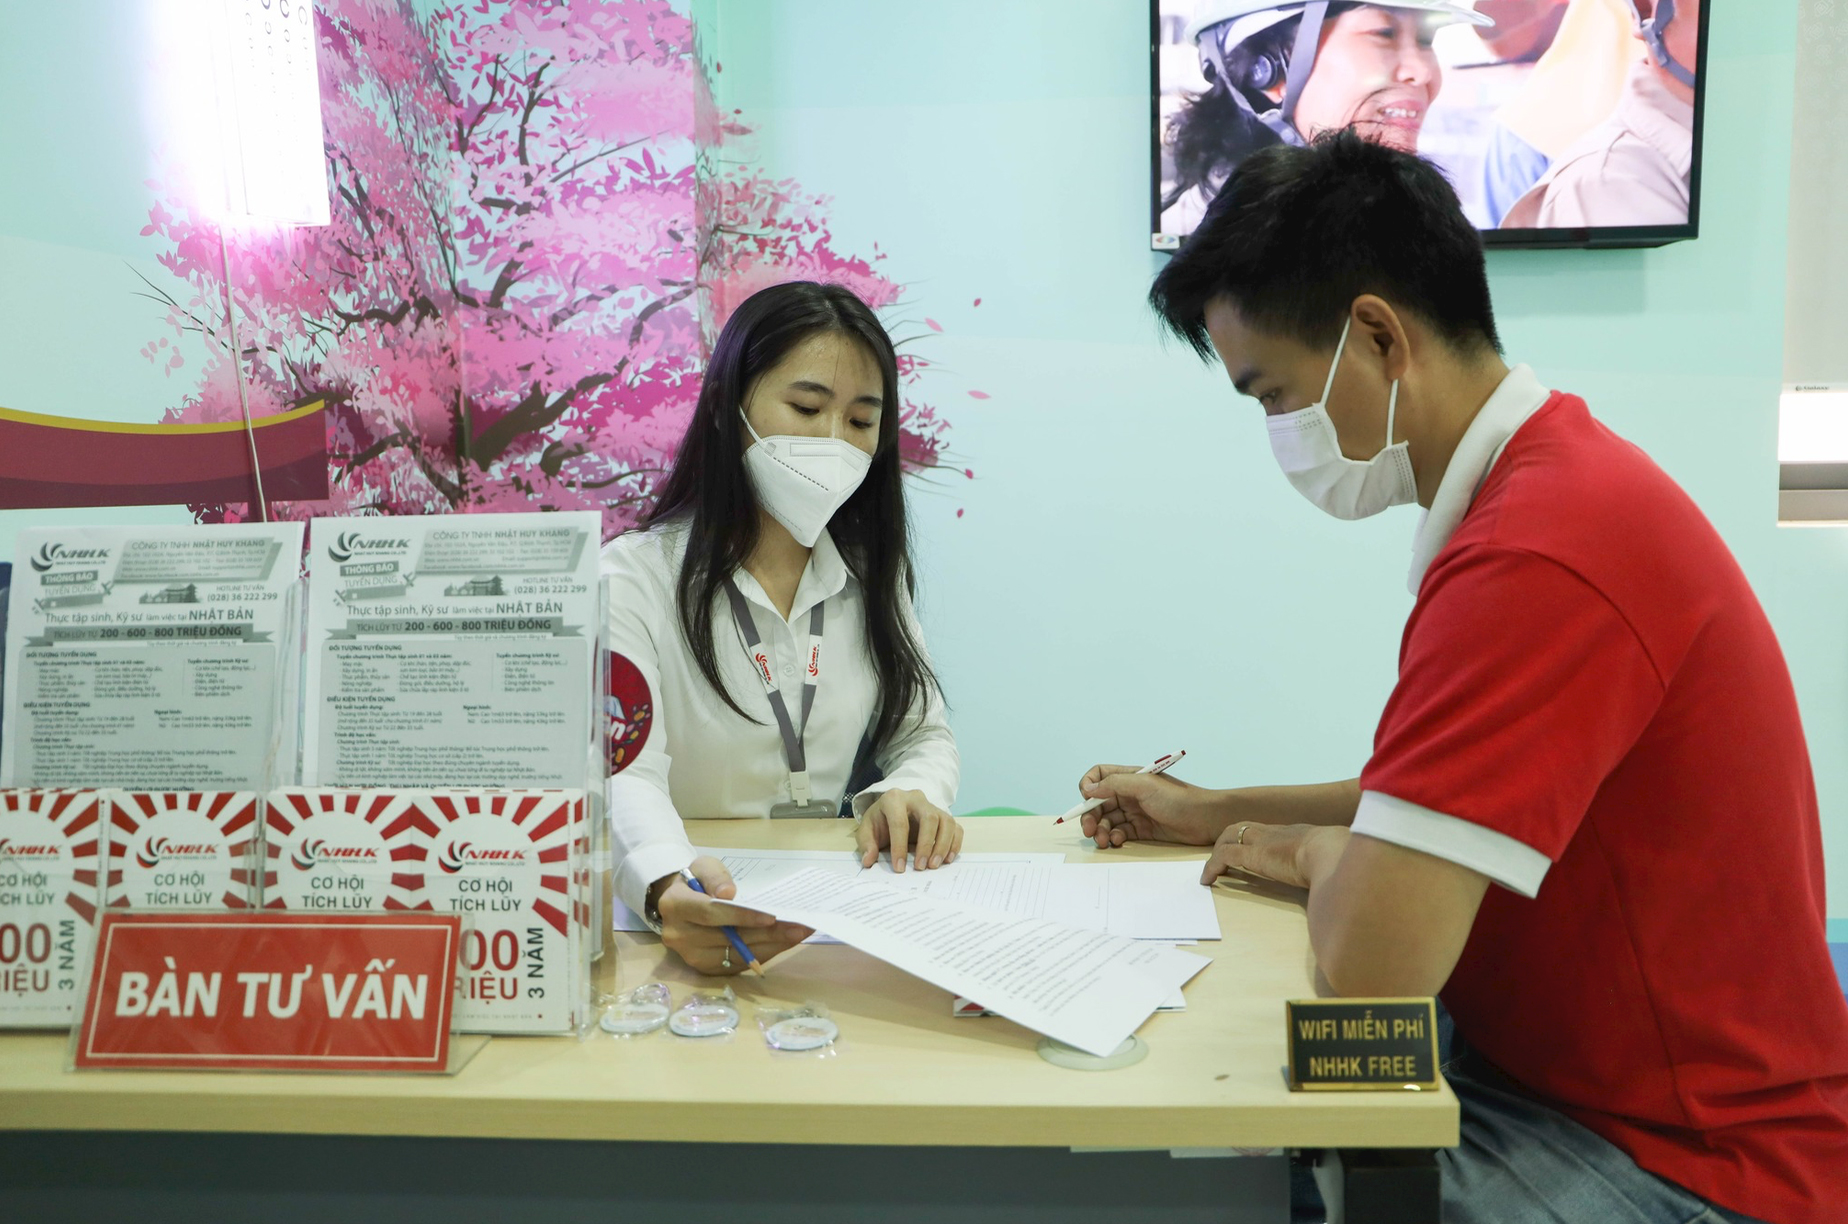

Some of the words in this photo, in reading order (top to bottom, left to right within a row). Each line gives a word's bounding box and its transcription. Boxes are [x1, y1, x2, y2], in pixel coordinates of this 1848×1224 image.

[433, 531, 459, 540] CÔNG
[461, 531, 470, 539] TY
[471, 531, 492, 539] TNHH
[495, 528, 517, 540] NHẬT
[520, 530, 536, 538] HUY
[539, 529, 570, 537] KHANG
[353, 539, 411, 549] NHHK
[345, 564, 374, 575] THÔNG
[376, 562, 394, 572] BÁO
[344, 577, 371, 588] TUYỂN
[372, 575, 398, 586] DỤNG
[514, 585, 537, 594] (028)
[539, 585, 550, 594] 36
[552, 585, 568, 594] 222
[571, 585, 587, 594] 299
[207, 593, 229, 602] (028)
[231, 593, 241, 602] 36
[244, 593, 260, 602] 222
[262, 593, 278, 602] 299
[45, 612, 68, 623] Thực
[72, 612, 89, 624] tập
[91, 612, 114, 623] sinh,
[116, 612, 129, 623] Kỹ
[130, 613, 142, 621] sư
[162, 613, 176, 622] việc
[178, 613, 188, 621] tại
[189, 607, 224, 624] NHẬT
[227, 606, 254, 620] BẢN
[347, 605, 371, 617] Thực
[375, 605, 392, 618] tập
[394, 605, 418, 616] sinh,
[421, 604, 434, 617] Kỹ
[437, 605, 449, 614] sư
[453, 606, 467, 614] làm
[468, 606, 484, 615] việc
[485, 606, 495, 614] tại
[496, 600, 532, 617] NHẬT
[535, 599, 563, 614] BẢN
[100, 628, 119, 638] 200
[127, 628, 146, 638] 600
[154, 628, 174, 638] 800
[176, 625, 207, 639] TRIỆU
[209, 624, 242, 637] ĐỒNG
[405, 621, 424, 631] 200
[433, 621, 453, 631] 600
[461, 621, 481, 631] 800
[484, 618, 515, 632] TRIỆU
[517, 617, 551, 630] ĐỒNG
[317, 847, 379, 858] NHHK
[465, 850, 527, 860] NHHK
[22, 870, 47, 889] HỘI
[154, 872, 178, 886] CƠ
[179, 870, 205, 888] HỘI
[311, 877, 334, 890] CƠ
[338, 875, 365, 891] HỘI
[459, 878, 482, 893] CƠ
[486, 877, 513, 895] HỘI
[26, 889, 56, 905] LŨY
[145, 890, 180, 904] TÍCH
[184, 889, 213, 905] LŨY
[302, 893, 338, 909] TÍCH
[343, 893, 373, 909] LŨY
[450, 896, 485, 912] TÍCH
[491, 896, 522, 912] LŨY
[54, 920, 75, 970] NĂM
[522, 928, 544, 978] NĂM
[58, 978, 75, 990] 3
[115, 956, 222, 1018] BÀN
[236, 963, 314, 1019] TƯ
[322, 958, 428, 1020] VẤN
[528, 987, 545, 999] 3
[1299, 1019, 1338, 1041] WIFI
[1342, 1010, 1388, 1041] MIỄN
[1393, 1013, 1424, 1039] PHÍ
[1309, 1056, 1363, 1077] NHHK
[1367, 1056, 1417, 1077] FREE
